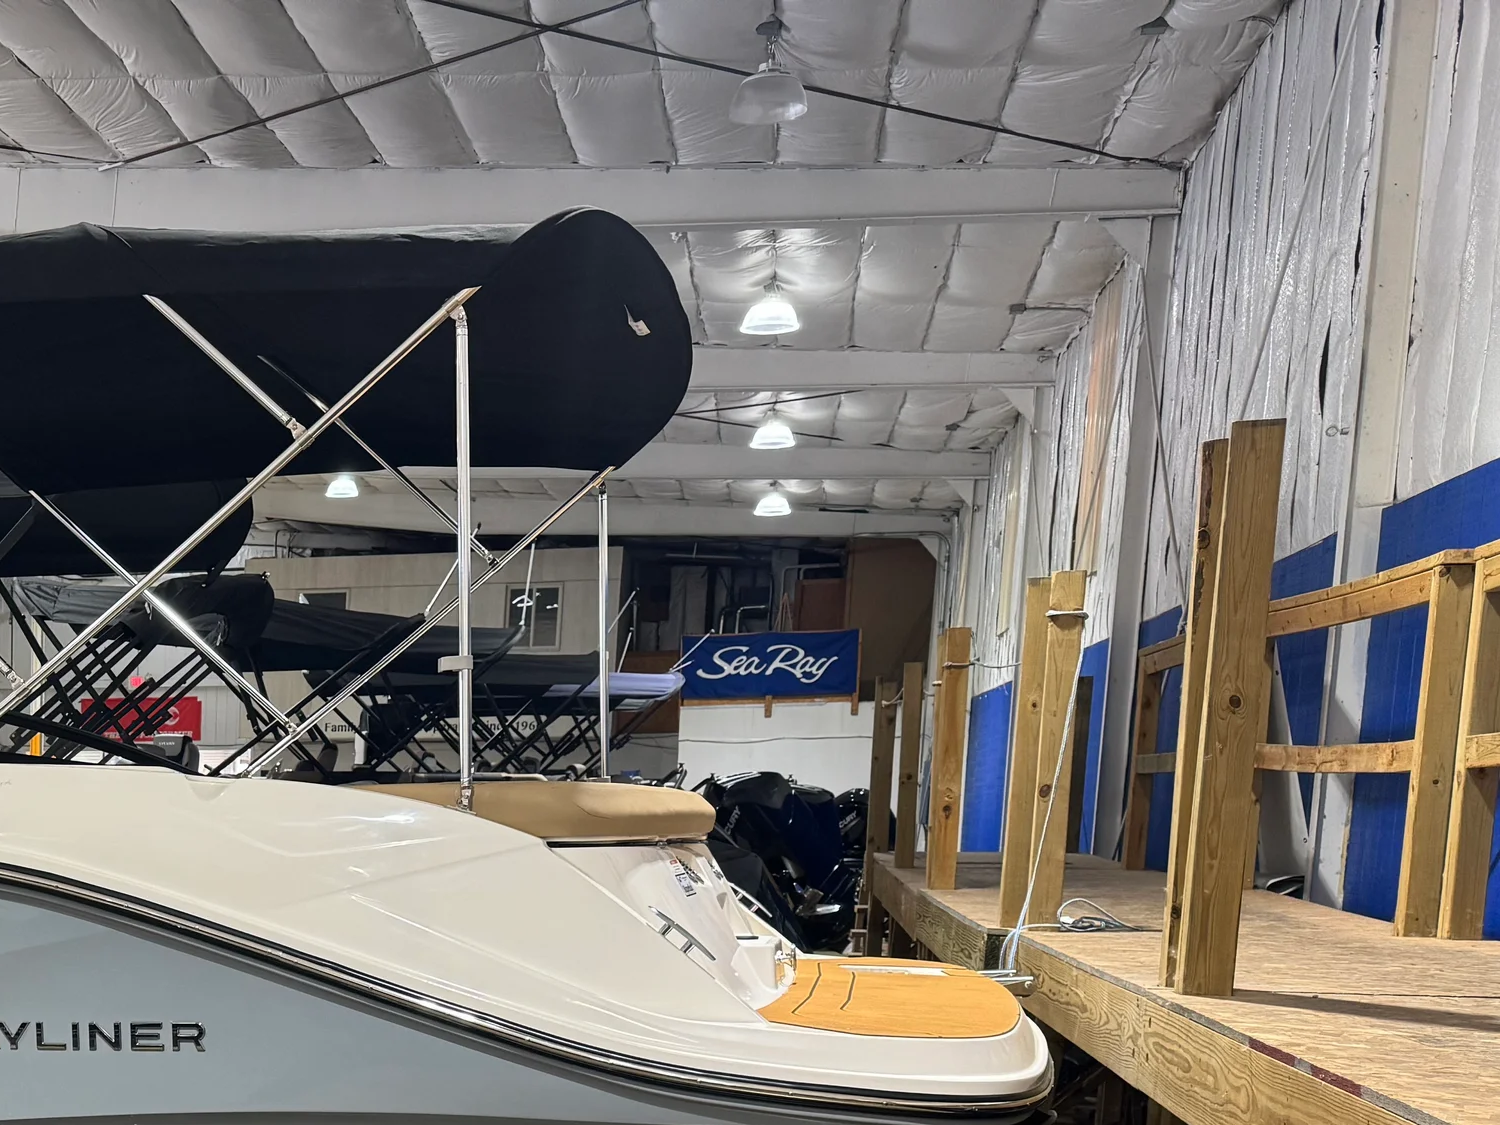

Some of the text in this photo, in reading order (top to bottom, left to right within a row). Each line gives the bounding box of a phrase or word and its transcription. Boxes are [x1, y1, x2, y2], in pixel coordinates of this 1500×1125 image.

[696, 644, 839, 683] Sea Ray
[515, 720, 536, 731] 196
[724, 805, 742, 836] CURY
[838, 810, 857, 829] CURY
